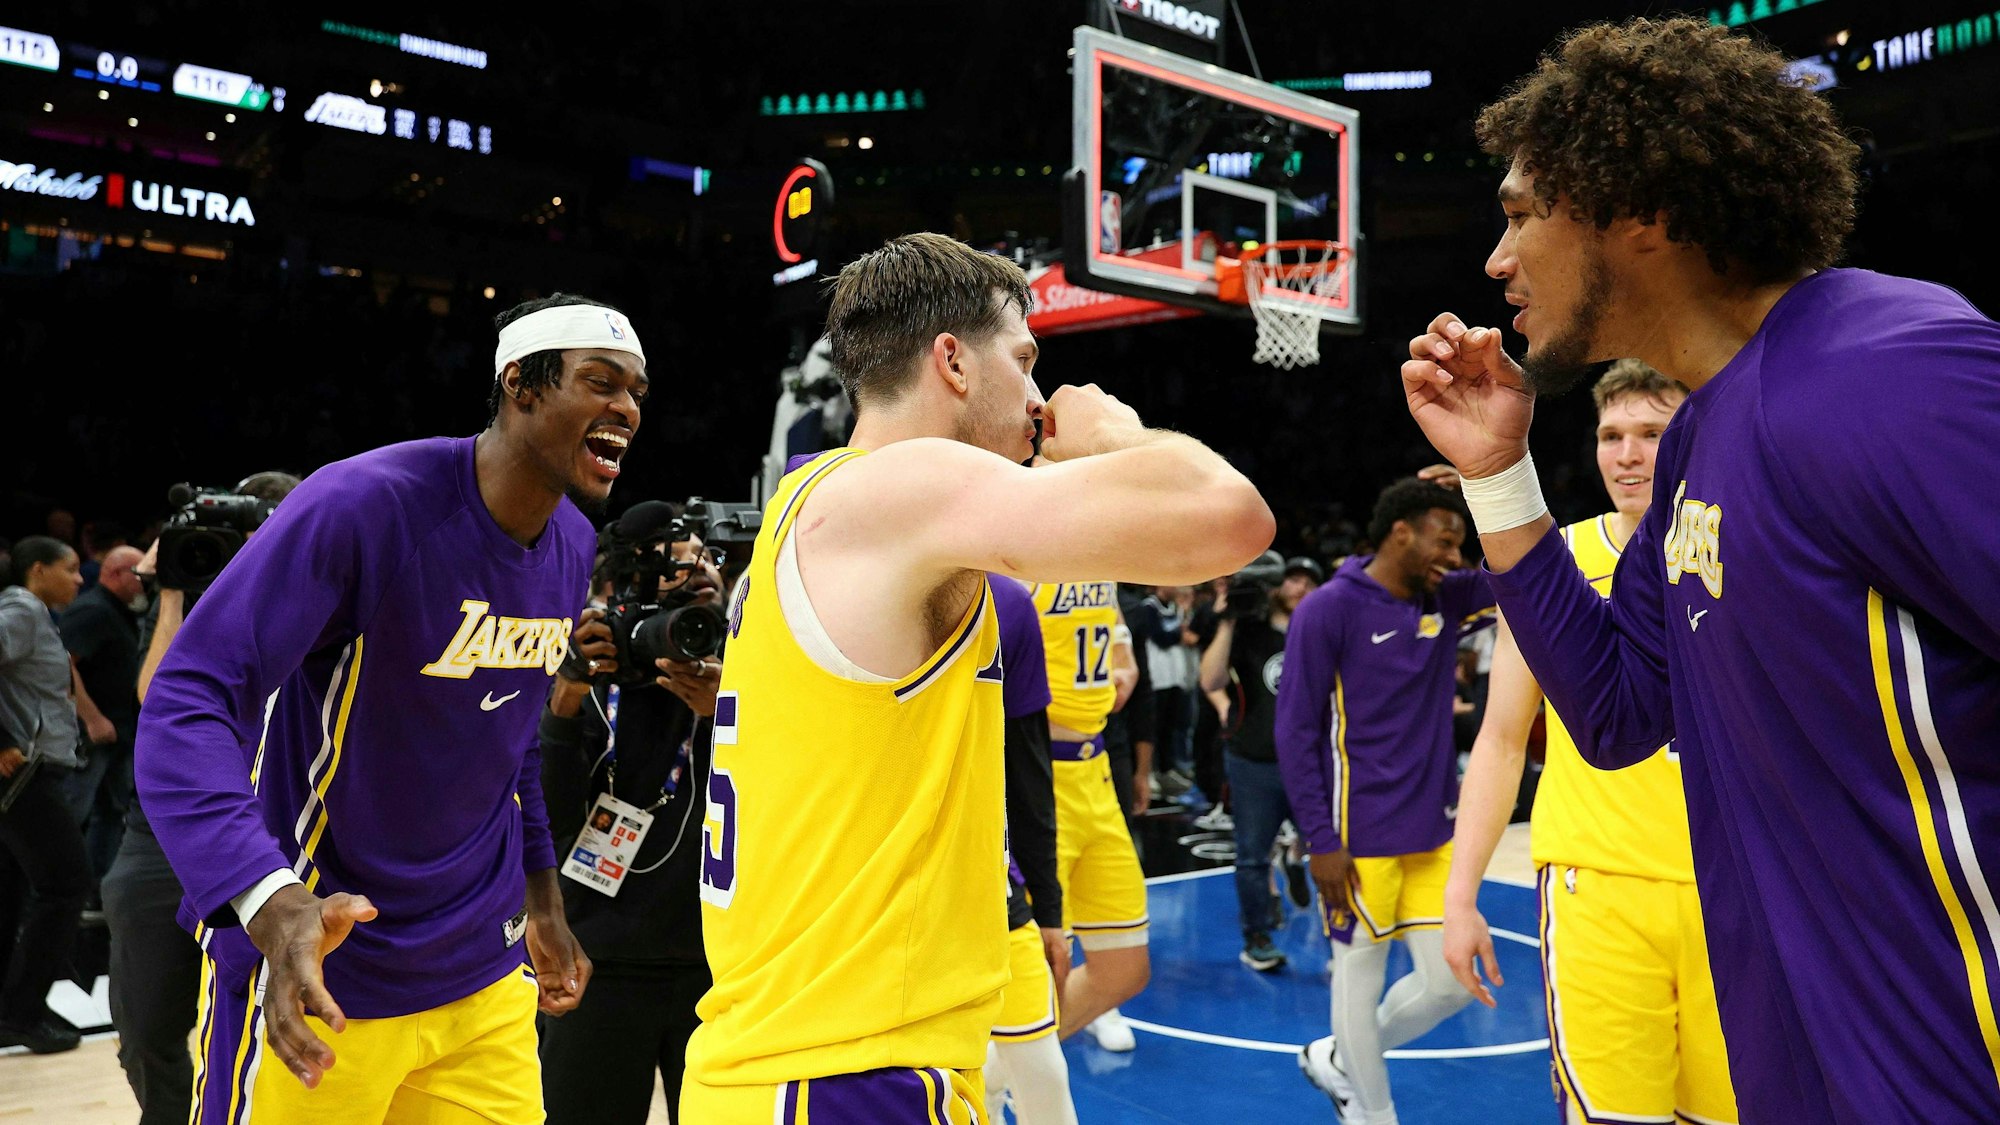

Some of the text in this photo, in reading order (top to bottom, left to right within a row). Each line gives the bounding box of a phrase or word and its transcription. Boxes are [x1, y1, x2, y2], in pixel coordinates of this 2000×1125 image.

[1139, 0, 1220, 40] TISSOT
[97, 52, 138, 81] 0.0
[1873, 27, 1936, 72] TAKE
[132, 180, 255, 226] ULTRA
[421, 600, 573, 679] LAKERS
[1074, 624, 1111, 689] 12
